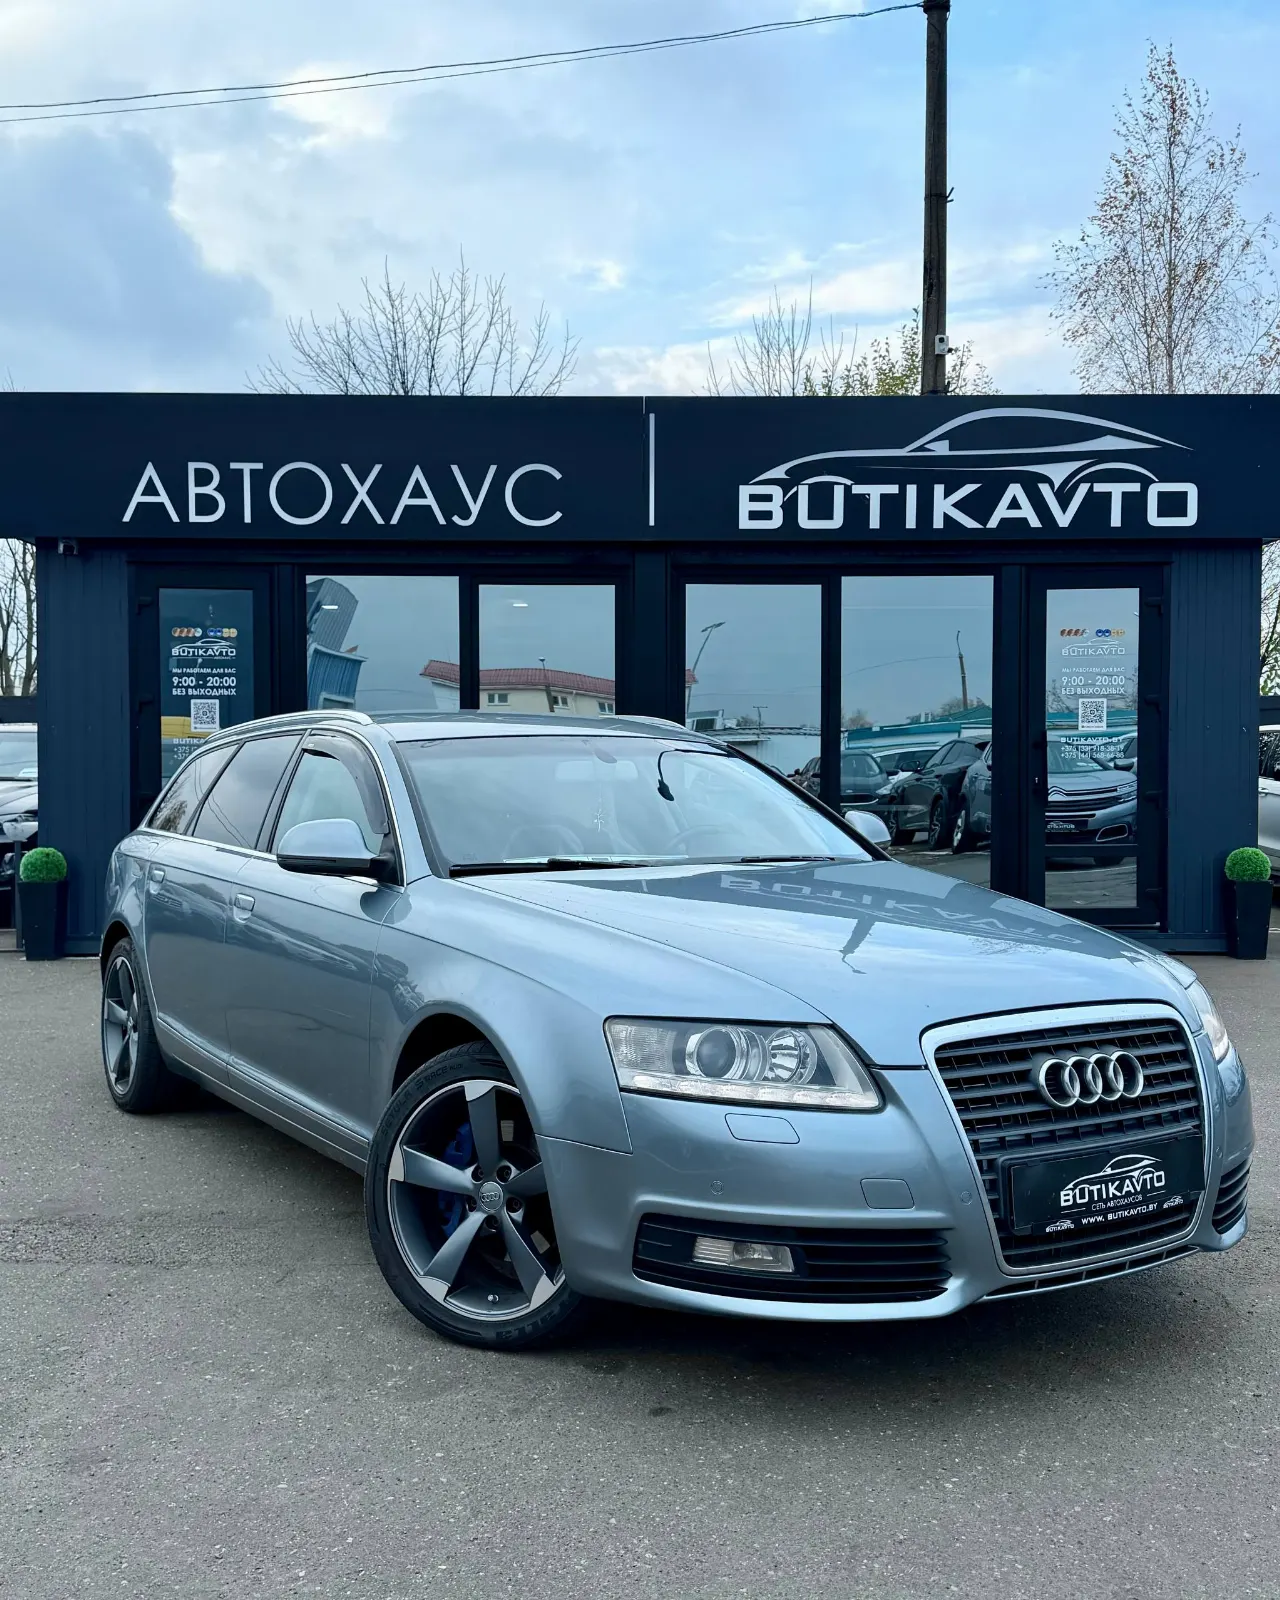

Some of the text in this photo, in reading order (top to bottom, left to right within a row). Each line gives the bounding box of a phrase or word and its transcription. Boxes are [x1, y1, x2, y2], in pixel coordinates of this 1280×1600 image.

[122, 461, 563, 527] АВТОХАУС
[738, 482, 1199, 530] BUTIKAVTO
[172, 648, 236, 656] BUTIKAVTO
[172, 677, 196, 686] 9:00
[206, 677, 236, 686] 20:00
[1062, 676, 1084, 685] 9:00
[1096, 676, 1125, 685] 20:00
[188, 688, 236, 696] ВЫХОДНЫХ
[1060, 1171, 1166, 1207] BUTIKAVTO
[1091, 1194, 1143, 1211] СЕТЬ АВТОХАУСОВ
[1081, 1202, 1158, 1225] WWW. BUTIKAVTO.BY
